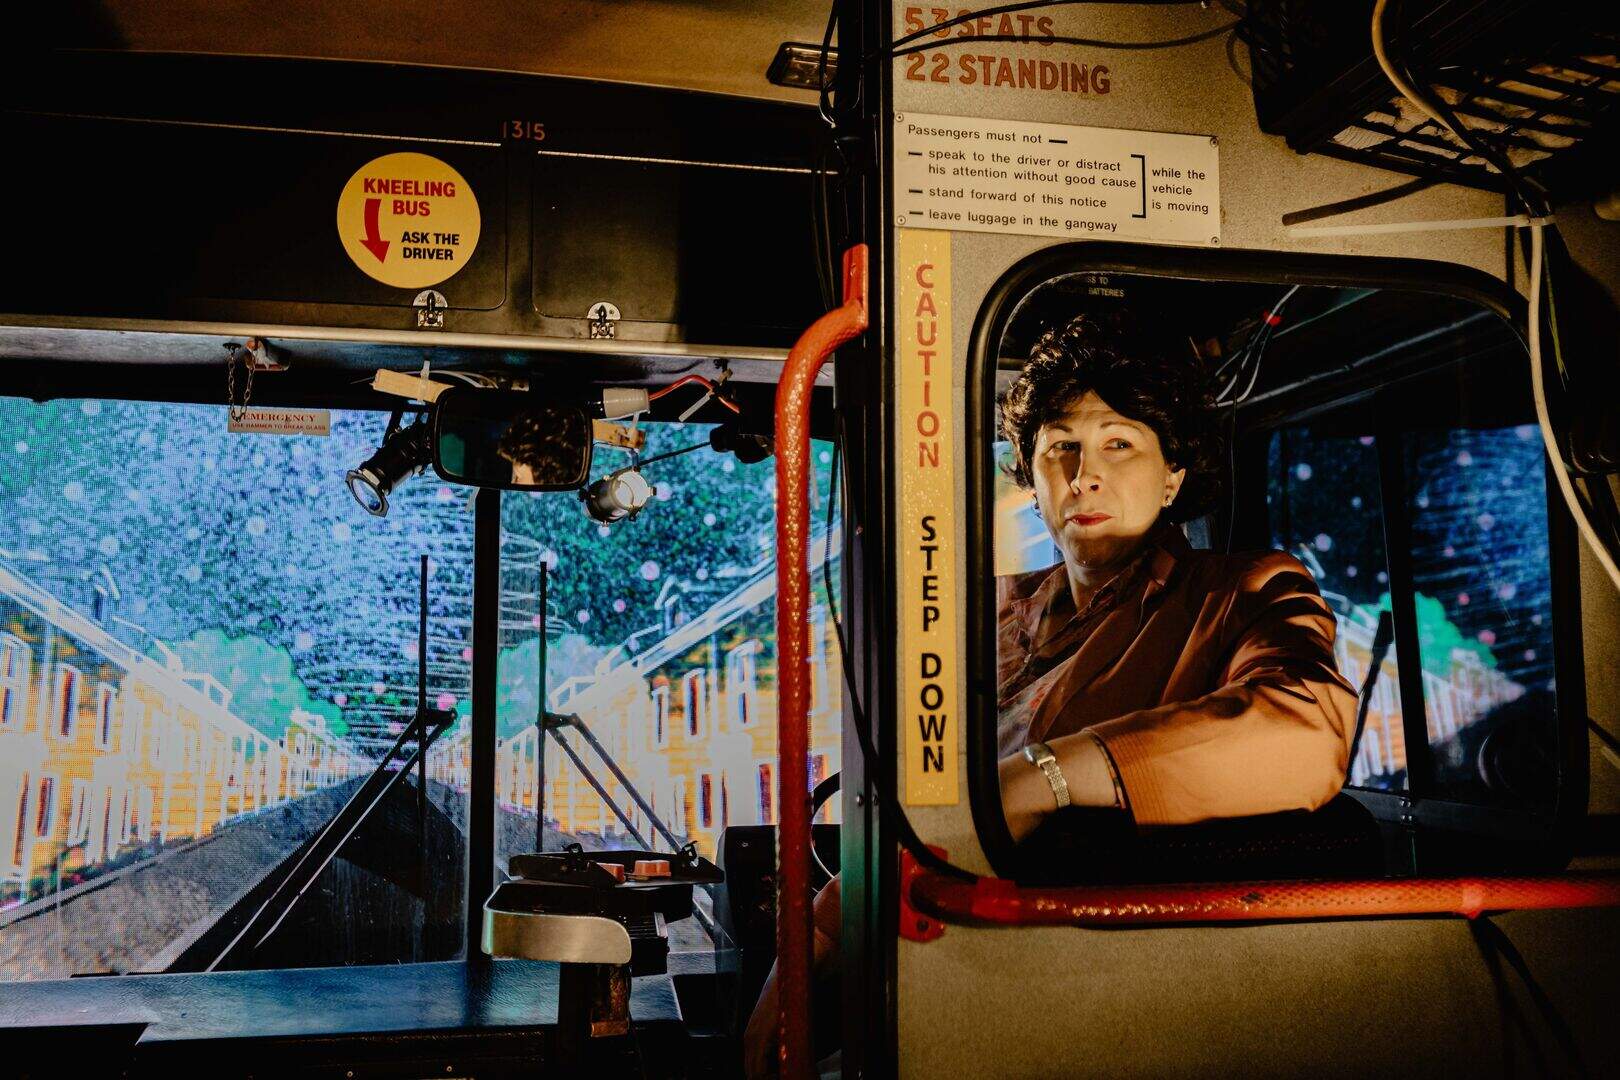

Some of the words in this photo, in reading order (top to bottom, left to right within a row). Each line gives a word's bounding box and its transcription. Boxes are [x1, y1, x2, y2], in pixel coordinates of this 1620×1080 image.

[905, 7, 950, 38] 53
[957, 9, 1055, 46] SEATS
[906, 52, 950, 83] 22
[959, 54, 1111, 95] STANDING
[502, 120, 546, 141] 1315
[908, 124, 980, 140] Passengers
[986, 132, 1016, 142] must
[1022, 134, 1042, 144] not
[928, 150, 966, 161] speak
[973, 151, 985, 162] to
[991, 153, 1011, 164] the
[1017, 155, 1051, 166] driver
[1057, 159, 1070, 168] or
[1076, 159, 1121, 172] distract
[928, 163, 946, 175] his
[952, 166, 1008, 179] attention
[1014, 171, 1058, 183] without
[1065, 175, 1096, 186] good
[1101, 178, 1137, 188] cause
[1152, 167, 1182, 179] while
[1187, 169, 1206, 180] the
[363, 178, 456, 198] KNEELING
[929, 187, 964, 199] stand
[970, 189, 1017, 202] forward
[1023, 193, 1036, 203] of
[1042, 194, 1064, 205] this
[1070, 196, 1107, 208] notice
[1152, 184, 1193, 195] vehicle
[392, 200, 431, 217] BUS
[1152, 199, 1162, 210] is
[1167, 202, 1209, 214] moving
[928, 209, 961, 221] leave
[968, 211, 1017, 226] luggage
[1023, 215, 1033, 225] in
[1040, 215, 1059, 227] the
[1065, 219, 1118, 232] gangway
[401, 231, 430, 244] ASK
[434, 232, 460, 246] THE
[402, 246, 454, 261] DRIVER
[1088, 287, 1125, 298] BATTERIES
[915, 264, 940, 468] CAUTION
[242, 412, 316, 423] EMERGENCY
[246, 422, 273, 430] HAMMER
[306, 424, 326, 432] GLASS
[920, 515, 941, 632] STEP
[918, 653, 947, 773] DOWN
